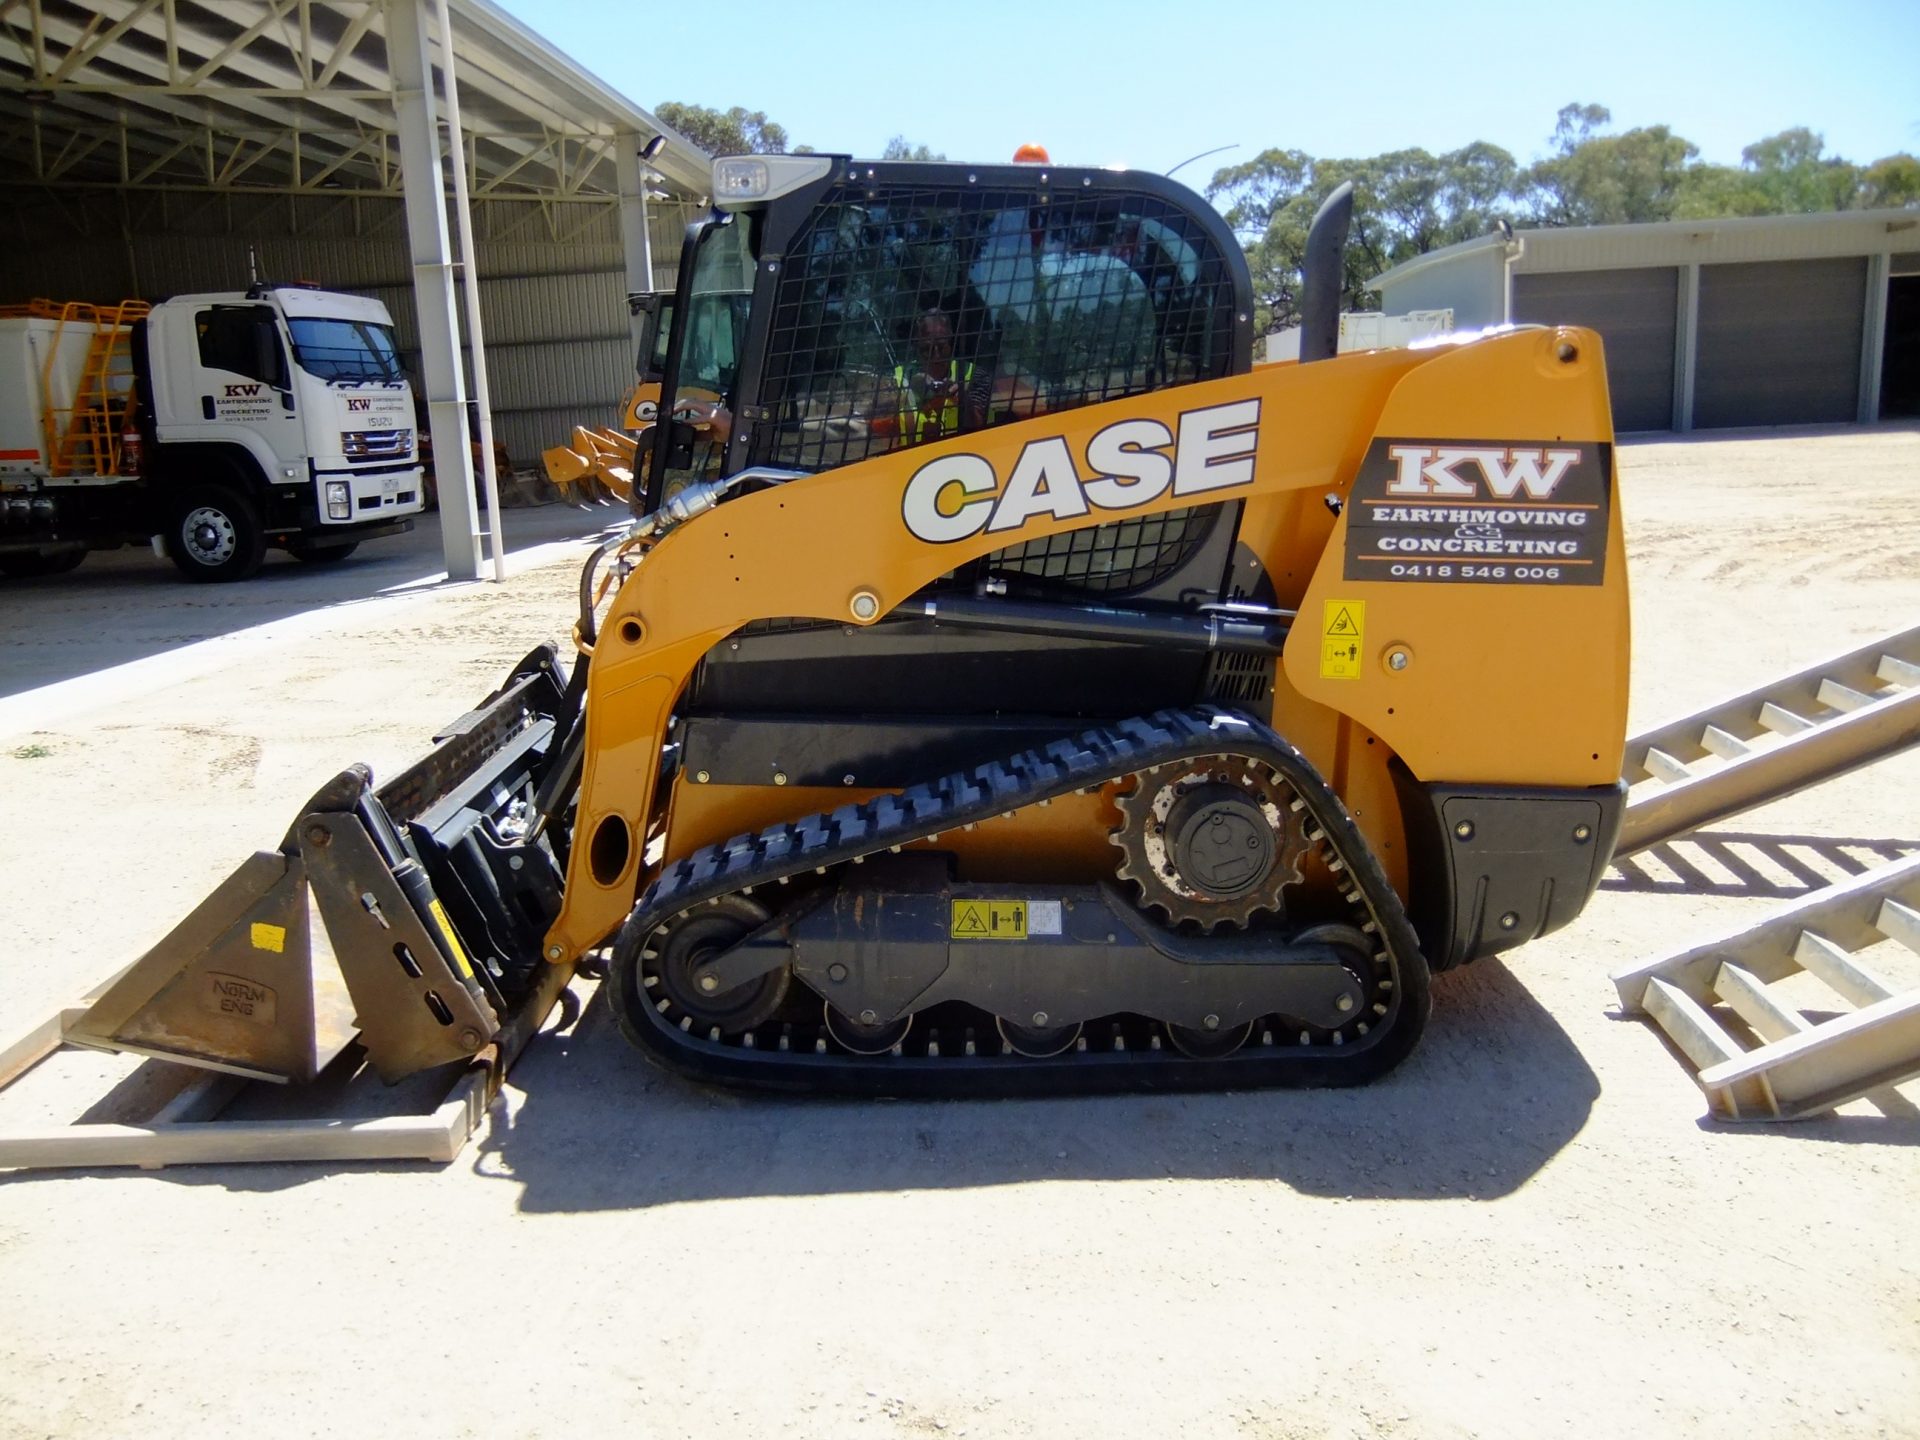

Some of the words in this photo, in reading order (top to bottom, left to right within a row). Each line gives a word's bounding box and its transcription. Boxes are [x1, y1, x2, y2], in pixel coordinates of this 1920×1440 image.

[224, 384, 261, 397] KW
[347, 399, 371, 411] KW
[368, 417, 393, 427] ISUZU
[901, 397, 1262, 544] CASE
[1386, 445, 1581, 499] KW
[1372, 507, 1586, 526] EARTHMOVING
[1377, 537, 1578, 555] CONCRETING
[1390, 564, 1452, 577] 0418
[1461, 566, 1506, 578] 546
[1514, 568, 1560, 579] 006
[212, 980, 265, 1002] NORM
[221, 999, 254, 1016] ENG
